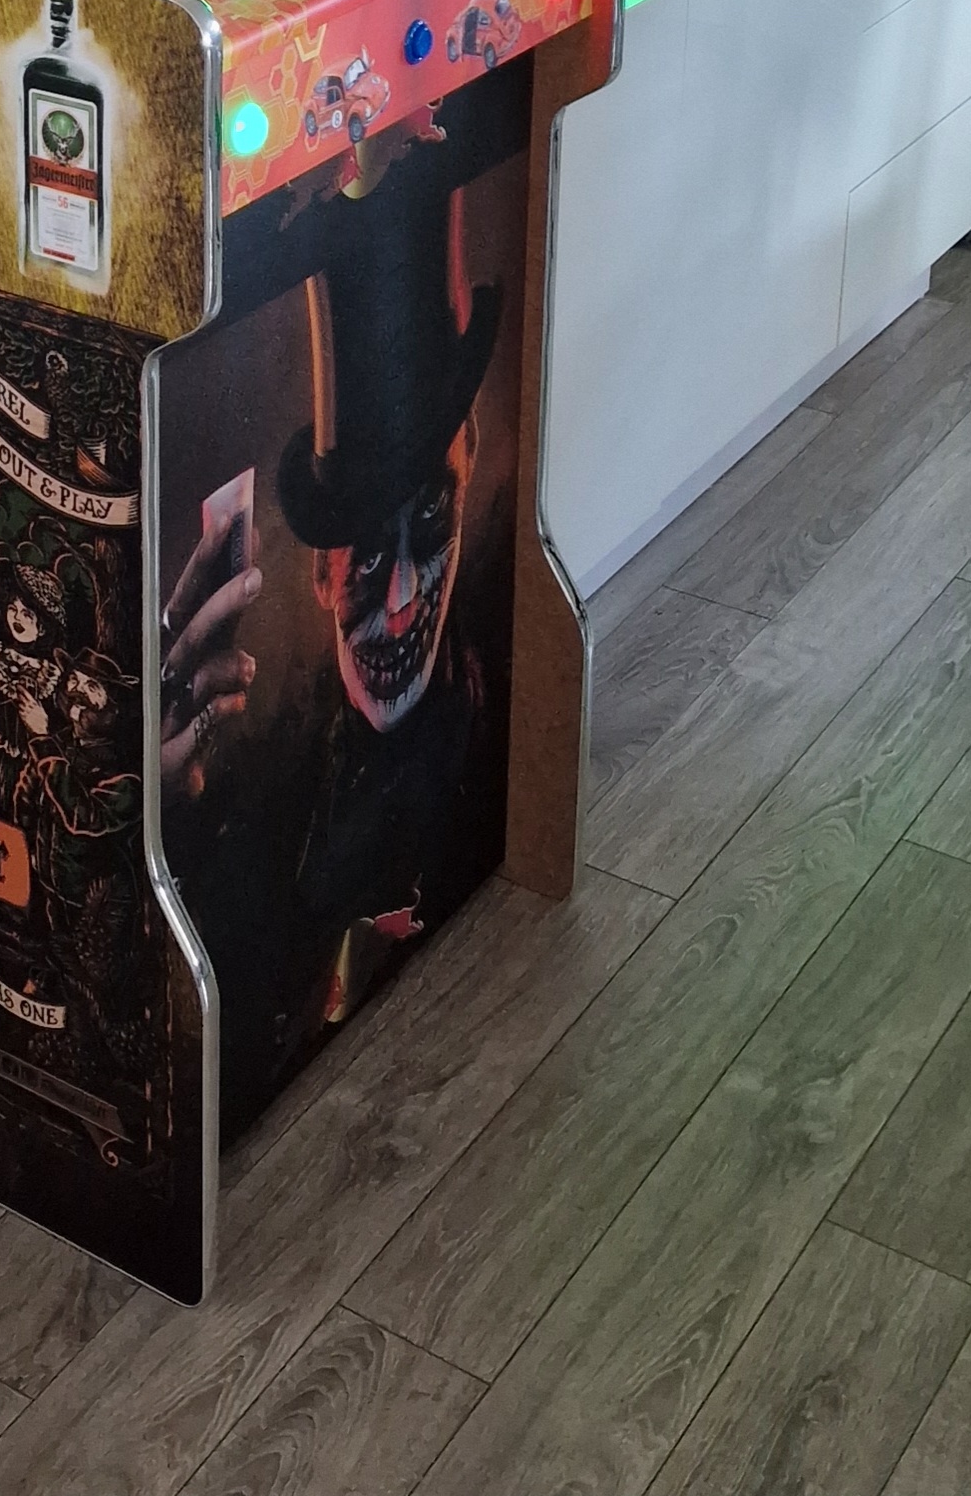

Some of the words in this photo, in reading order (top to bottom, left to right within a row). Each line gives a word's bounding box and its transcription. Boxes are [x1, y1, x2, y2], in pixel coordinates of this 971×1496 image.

[57, 195, 69, 209] 56
[39, 478, 58, 499] &
[59, 488, 114, 520] PLAY
[20, 999, 59, 1026] ONE
